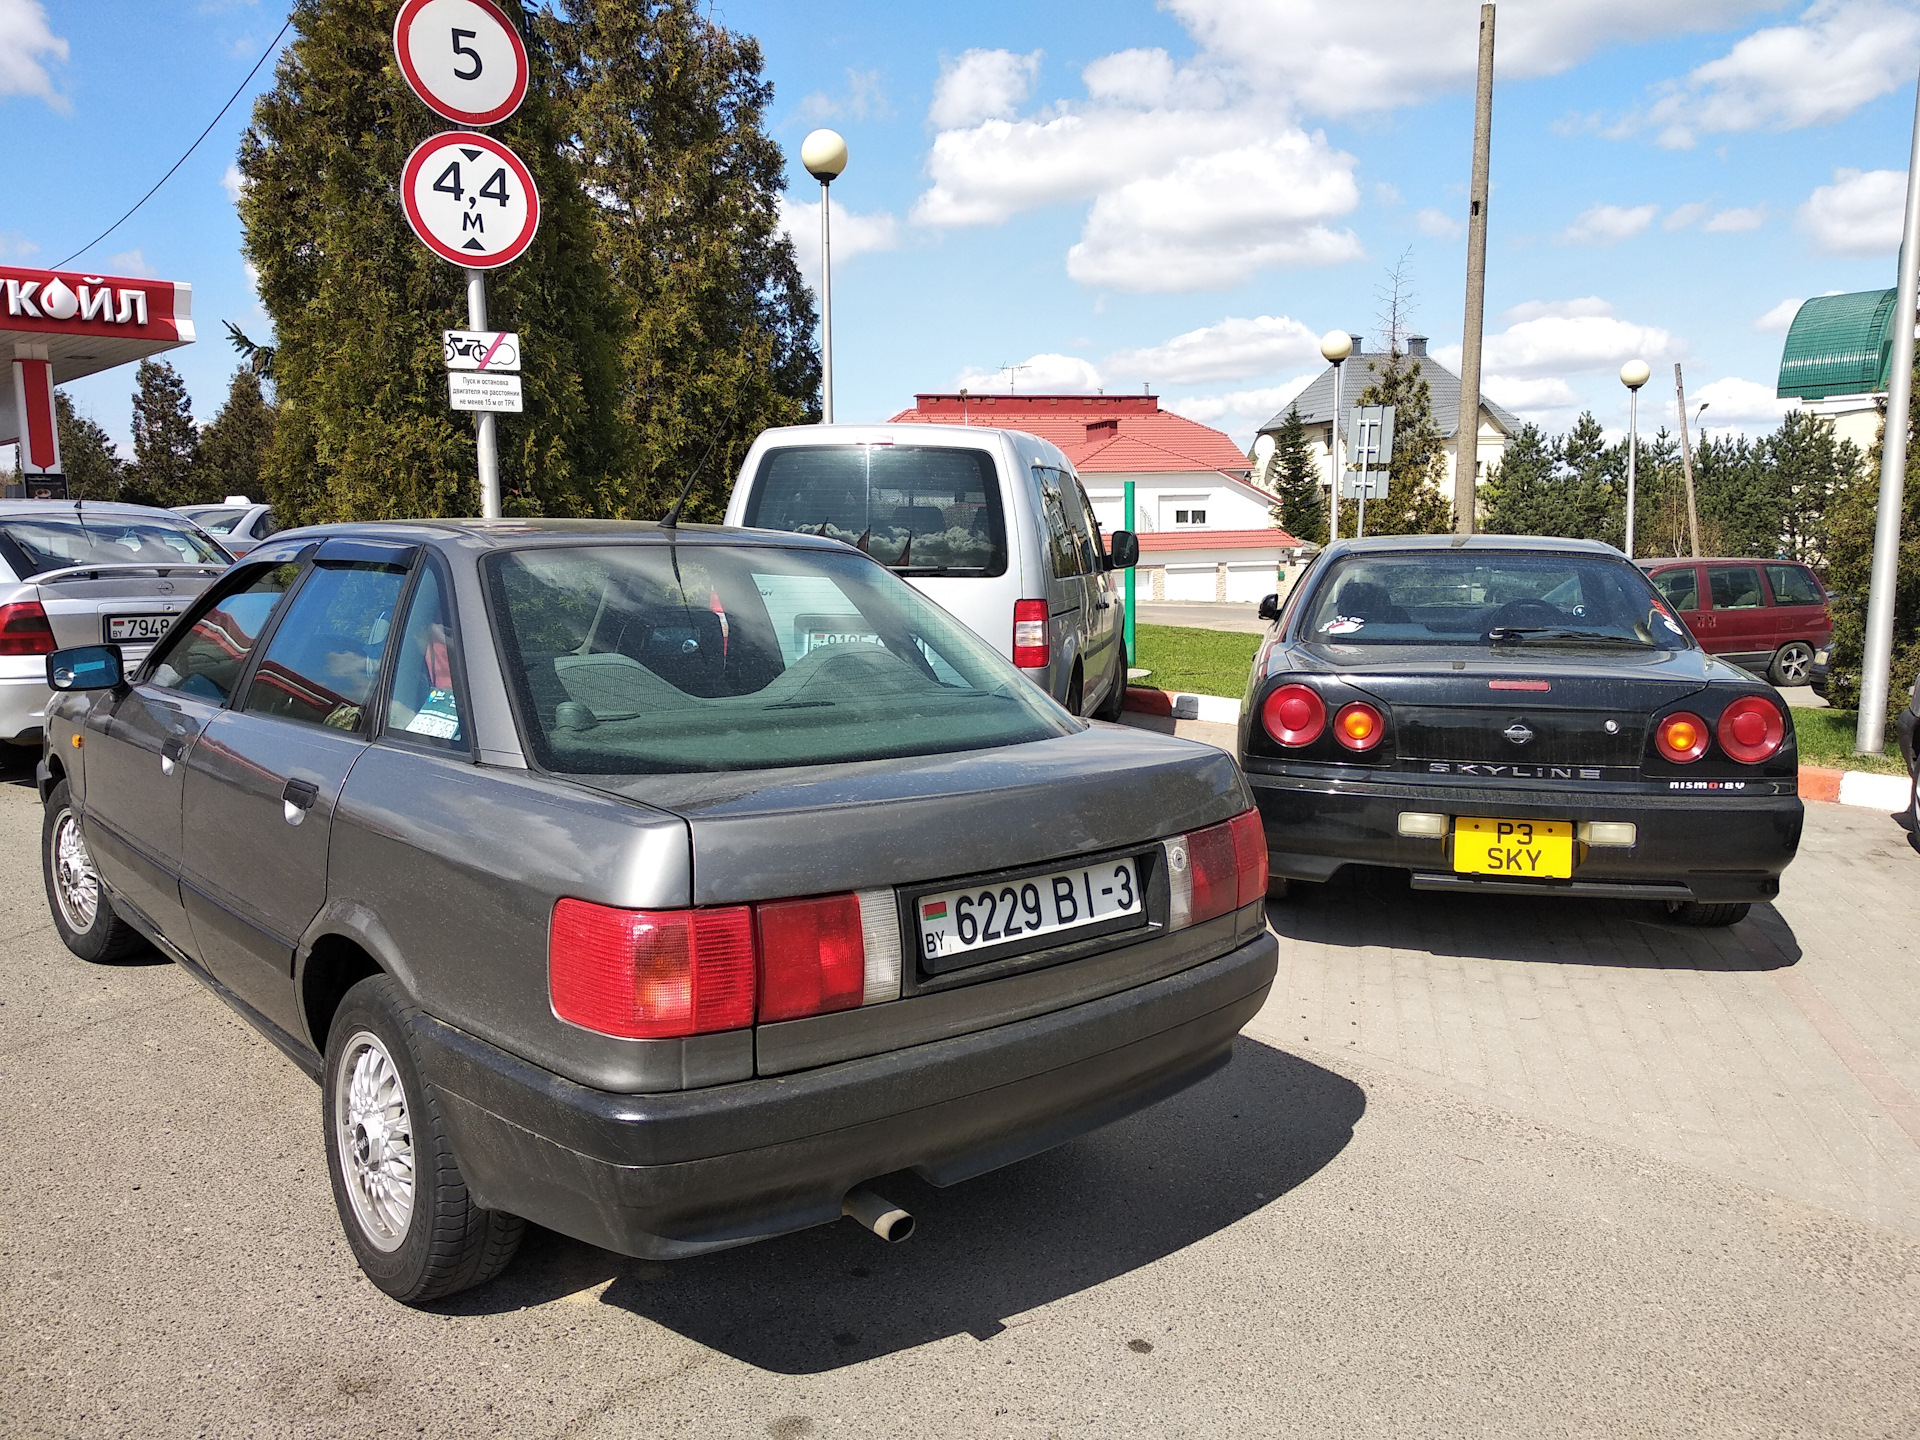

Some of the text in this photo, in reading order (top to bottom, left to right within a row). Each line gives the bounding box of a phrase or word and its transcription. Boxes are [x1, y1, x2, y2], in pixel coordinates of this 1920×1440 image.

[451, 27, 483, 81] 5
[432, 161, 511, 209] 4,4
[462, 376, 477, 386] Пуск
[485, 398, 491, 406] 15
[504, 399, 515, 407] ТРК
[112, 630, 123, 638] BY
[127, 619, 170, 637] 7948
[1428, 762, 1601, 780] SKYLINE
[1497, 822, 1533, 846] P3
[1487, 847, 1542, 872] SKY
[955, 882, 1042, 946] 6229
[925, 930, 945, 953] BY
